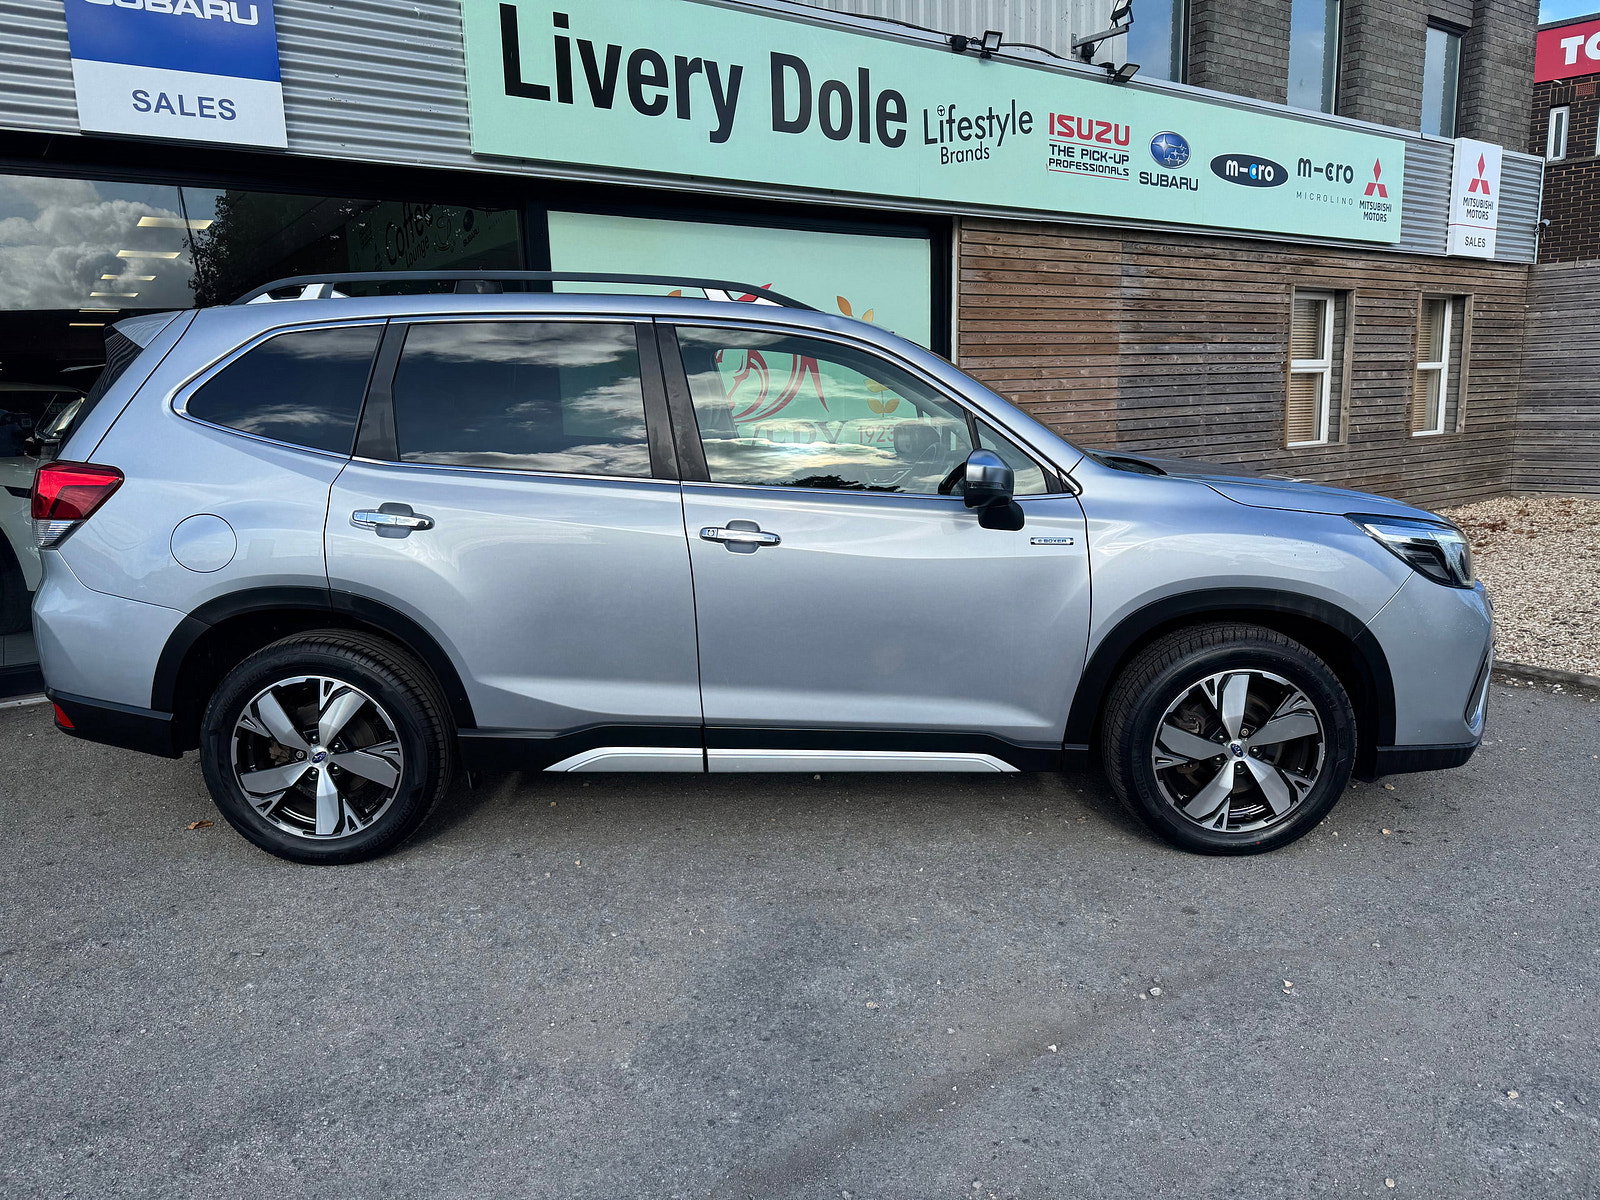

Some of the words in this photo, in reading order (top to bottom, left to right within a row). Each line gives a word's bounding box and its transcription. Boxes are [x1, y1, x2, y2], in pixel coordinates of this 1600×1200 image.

[499, 3, 743, 144] Livery
[770, 51, 907, 148] Dole
[132, 89, 237, 120] SALES
[923, 99, 1033, 147] Lifestyle
[1049, 112, 1130, 146] ISUZU
[940, 142, 990, 165] Brands
[1049, 144, 1075, 158] THE
[1081, 149, 1129, 164] PICK-UP
[1049, 158, 1129, 176] PROFESSIONALS
[1139, 171, 1199, 191] SUBARU
[1296, 191, 1354, 206] MICROLINO
[1359, 200, 1392, 213] MITSUBISHI
[1462, 197, 1494, 210] MITSUBISHI
[1363, 211, 1387, 222] MOTORS
[1466, 209, 1489, 220] MOTORS
[1465, 236, 1486, 248] SALES
